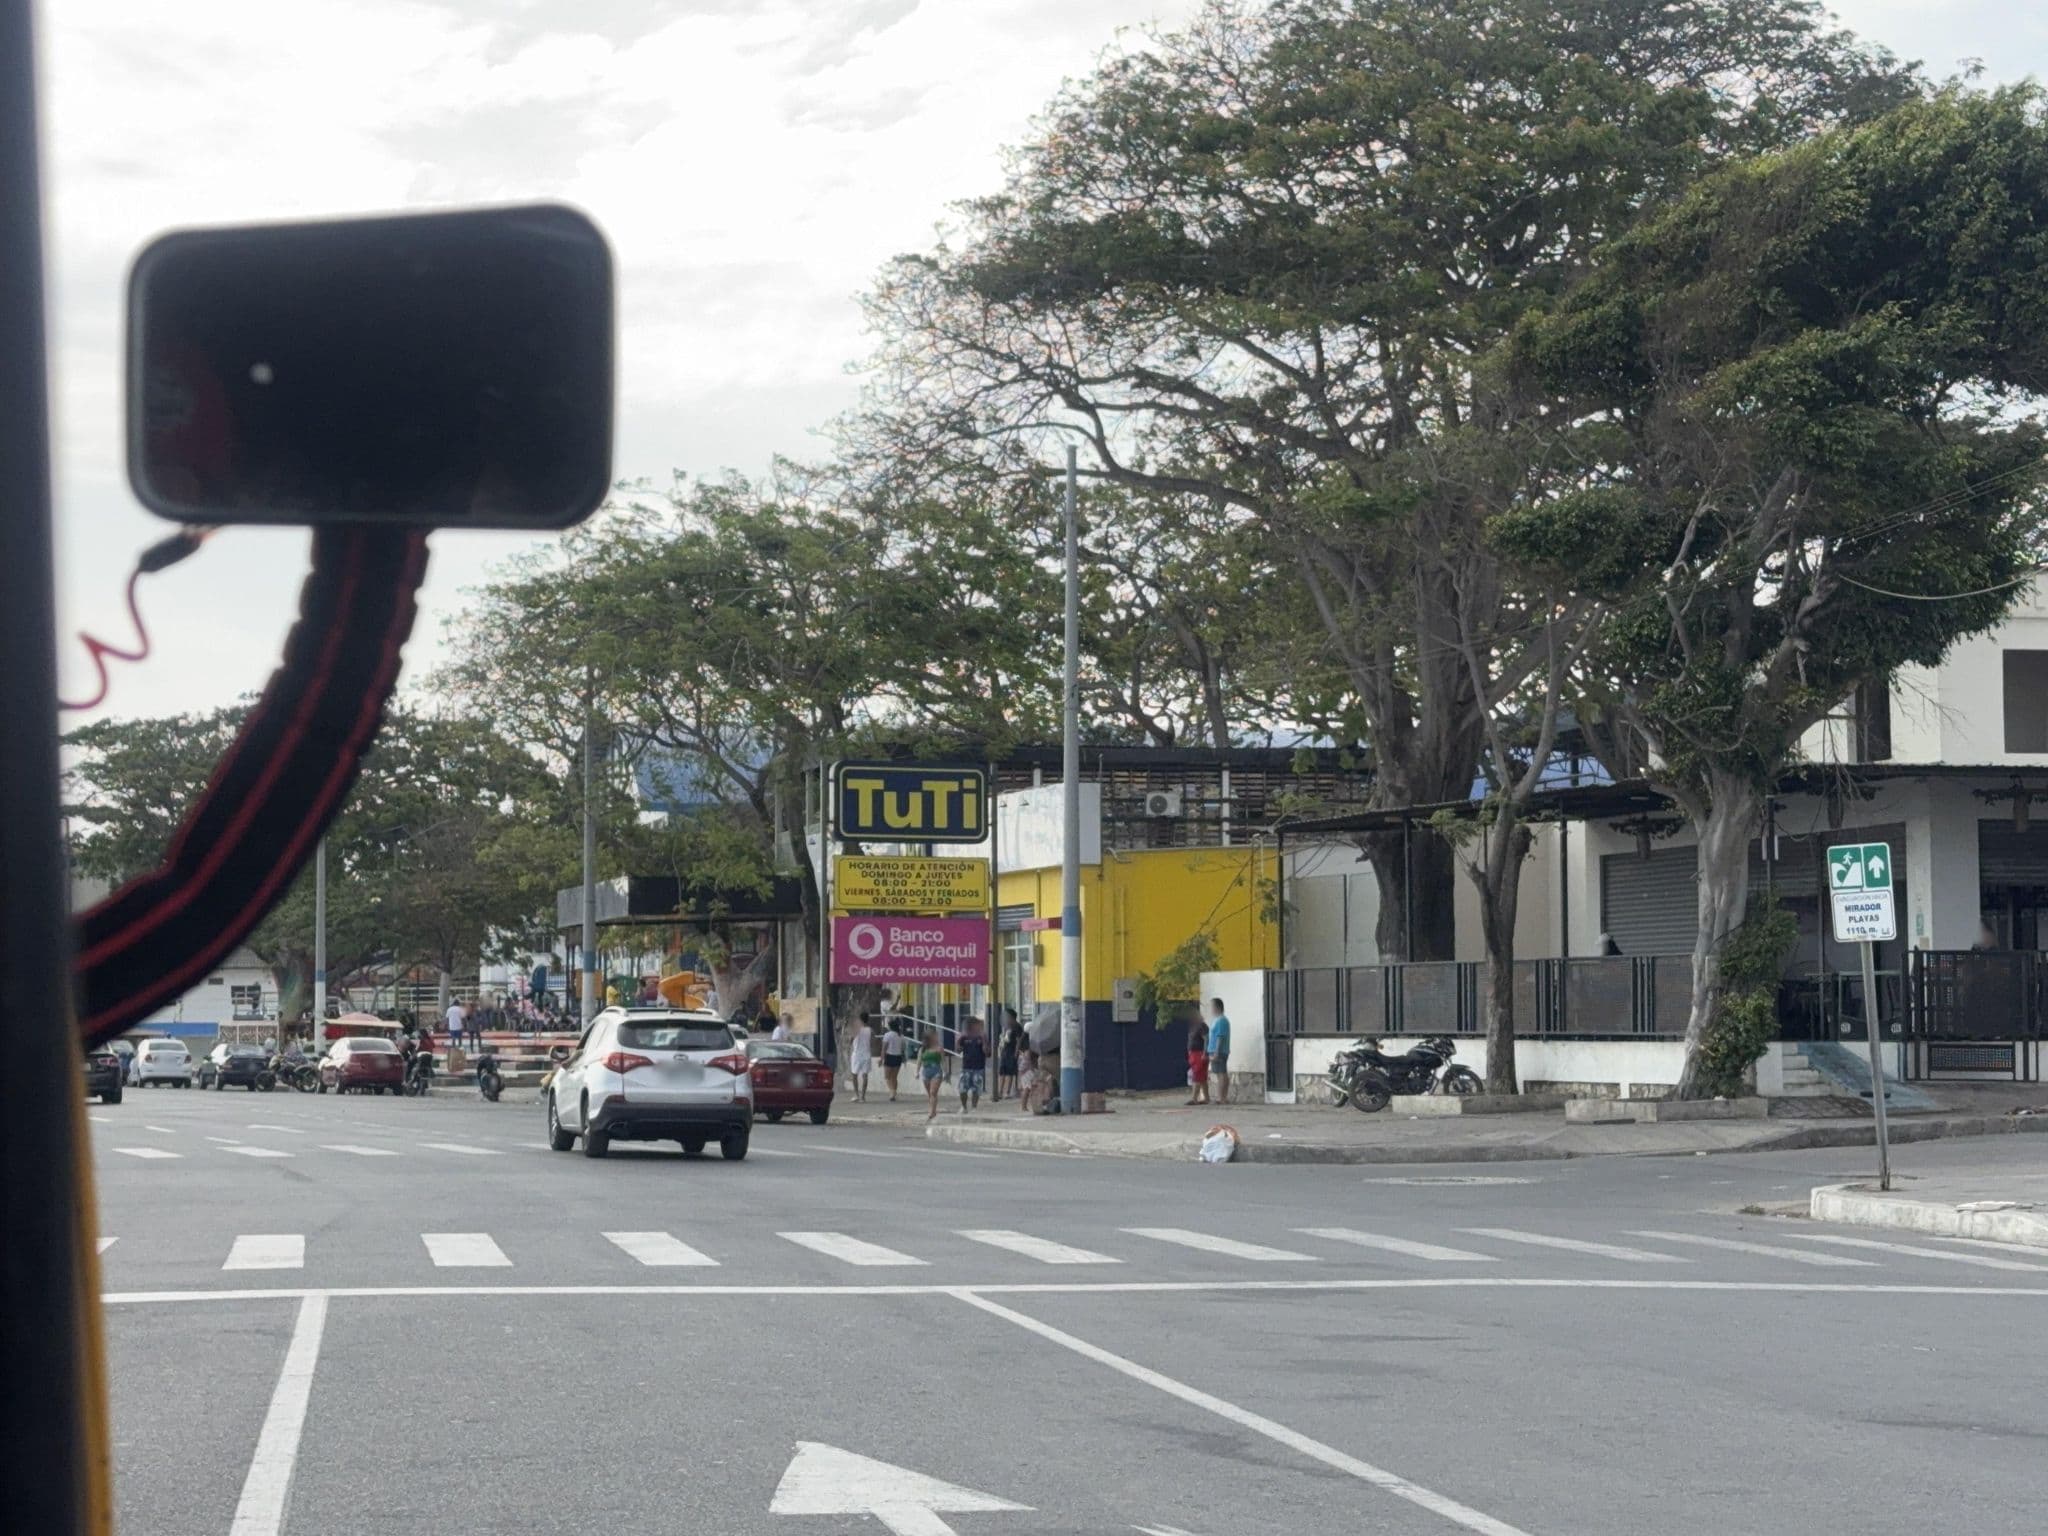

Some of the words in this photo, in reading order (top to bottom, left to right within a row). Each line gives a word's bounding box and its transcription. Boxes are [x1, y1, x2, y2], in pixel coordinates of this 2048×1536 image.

[847, 779, 977, 829] TuTi
[848, 861, 899, 871] HORARIO
[903, 863, 916, 871] DE
[919, 861, 975, 872] ATENCIÓN
[861, 871, 912, 879] DOMINGO
[915, 871, 922, 879] A
[925, 871, 963, 880] JUEVES
[873, 879, 908, 887] 08:00
[921, 879, 951, 887] 21:00
[885, 887, 927, 897] SÁBADOS
[929, 889, 935, 897] Y
[937, 889, 979, 898] FERIADOS
[1844, 903, 1882, 912] MIRADOR
[1848, 914, 1880, 924] PLAYAS
[889, 927, 944, 943] Banco
[889, 942, 977, 962] Guayaquil
[848, 964, 894, 979] Cajero
[897, 965, 976, 978] automático
